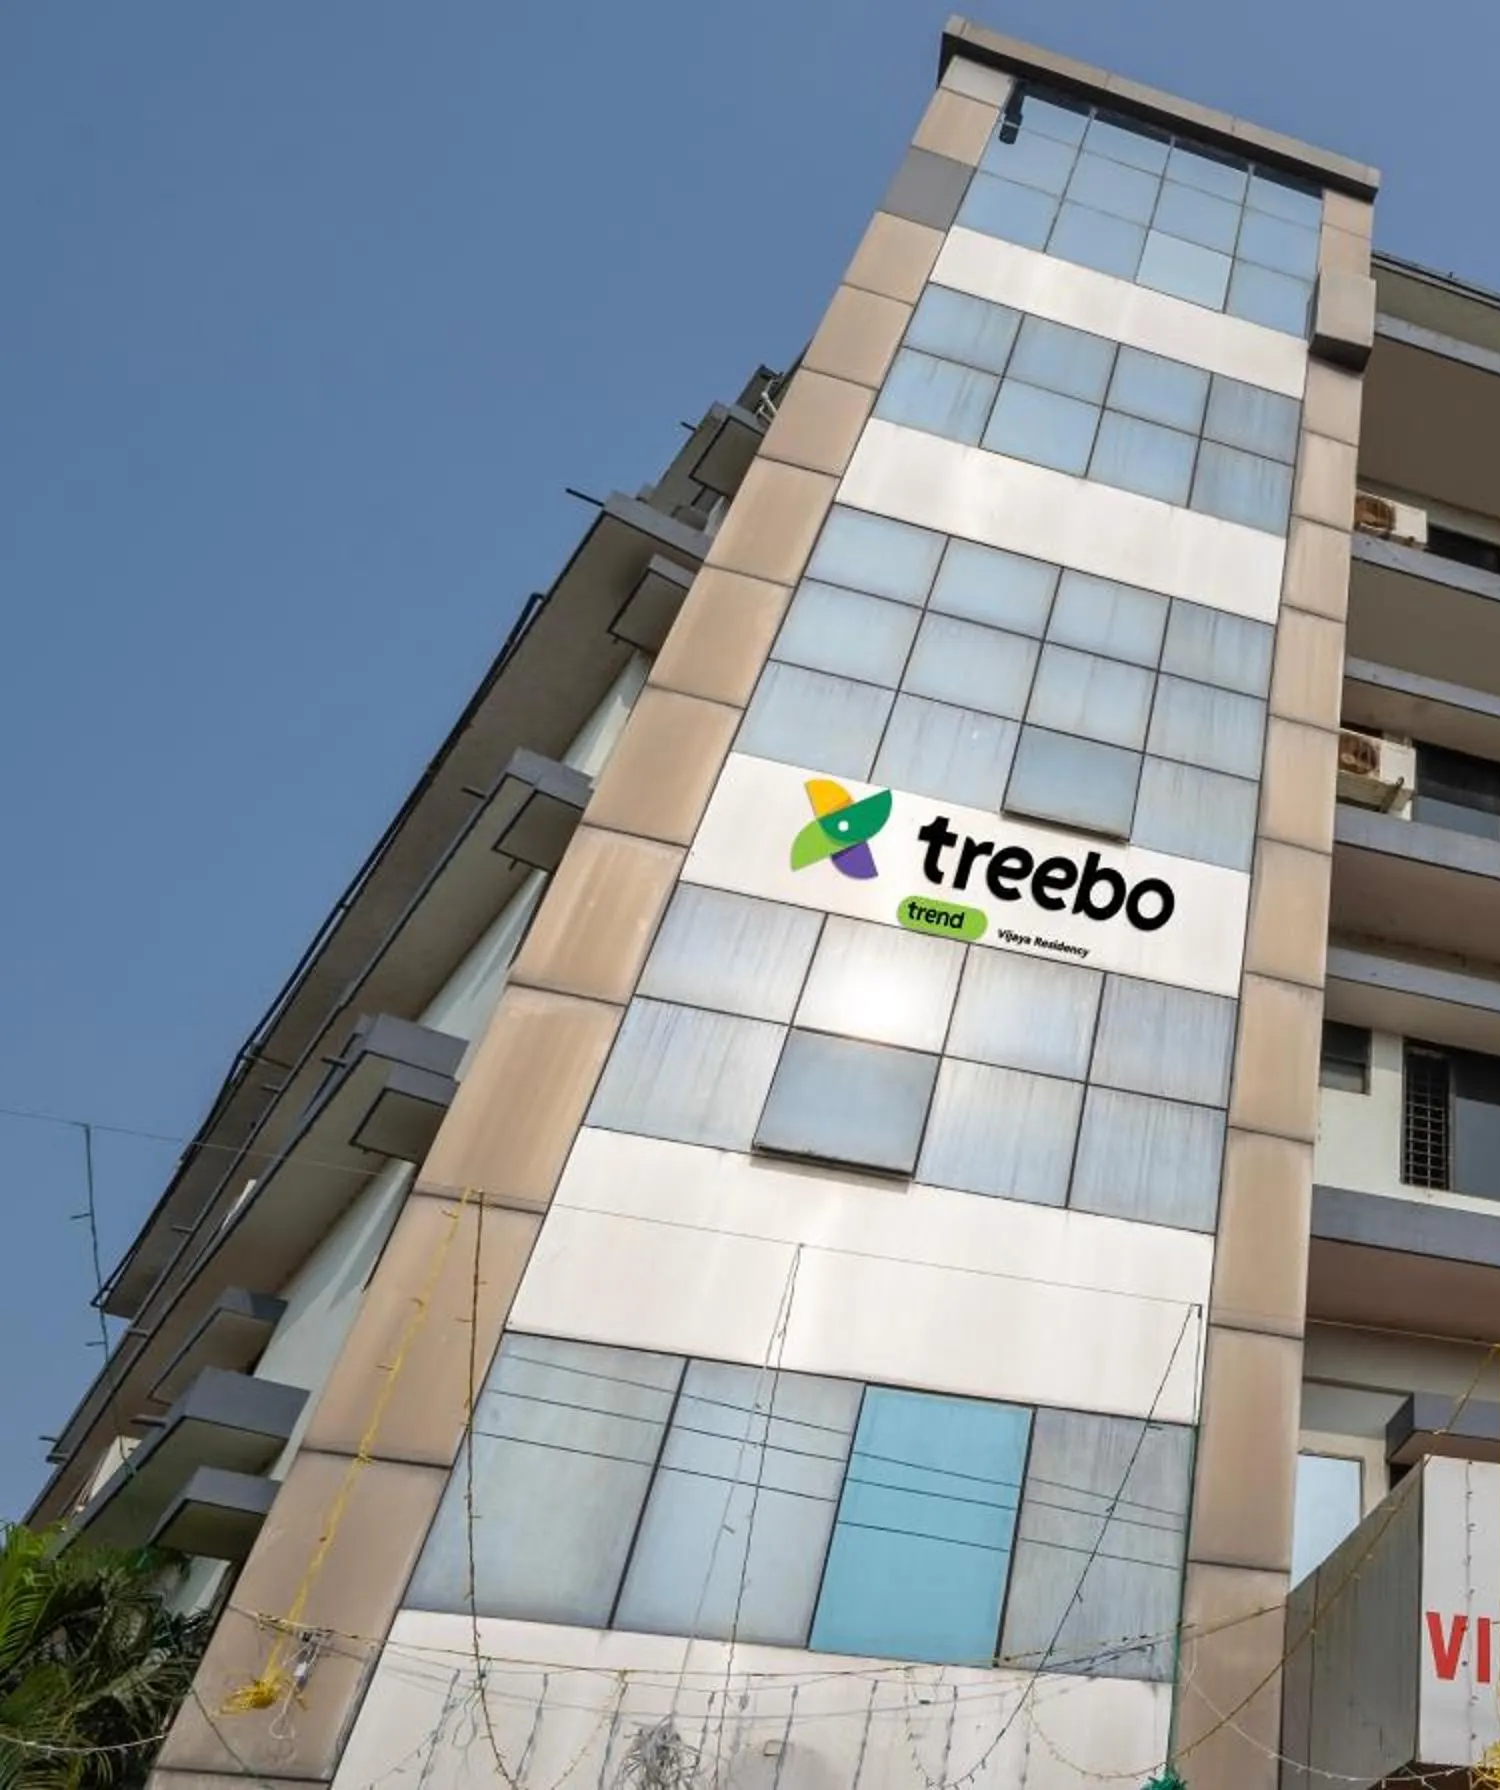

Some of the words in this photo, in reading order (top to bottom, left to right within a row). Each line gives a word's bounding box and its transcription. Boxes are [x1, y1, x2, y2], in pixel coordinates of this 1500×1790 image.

[917, 815, 1176, 932] treebo
[907, 900, 966, 930] trend
[997, 928, 1032, 946] Vijaya
[1033, 936, 1090, 959] Residency
